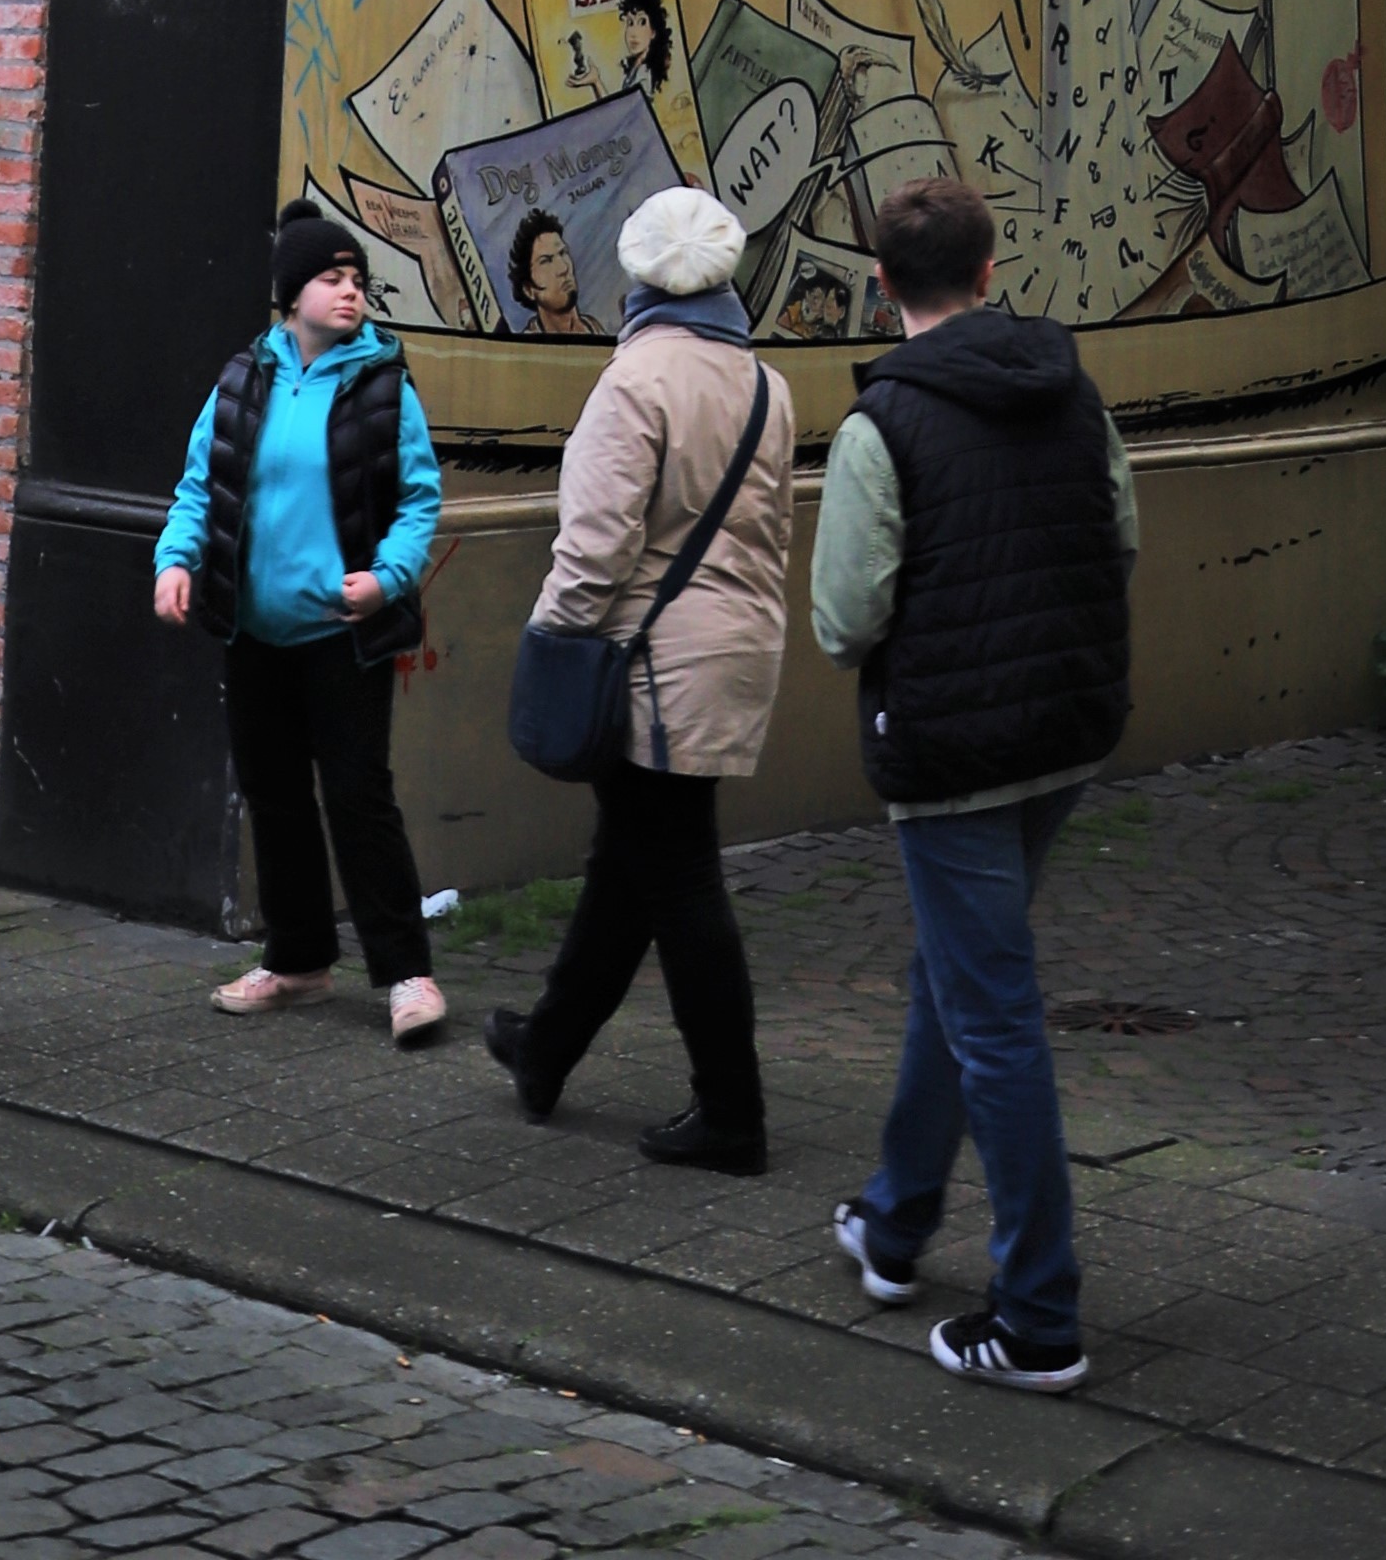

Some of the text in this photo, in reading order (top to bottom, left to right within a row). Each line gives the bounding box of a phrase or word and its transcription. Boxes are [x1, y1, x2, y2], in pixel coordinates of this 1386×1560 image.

[476, 134, 633, 206] Dog Mengo
[567, 177, 607, 206] JAGUAR
[445, 203, 493, 325] JAGUAR
